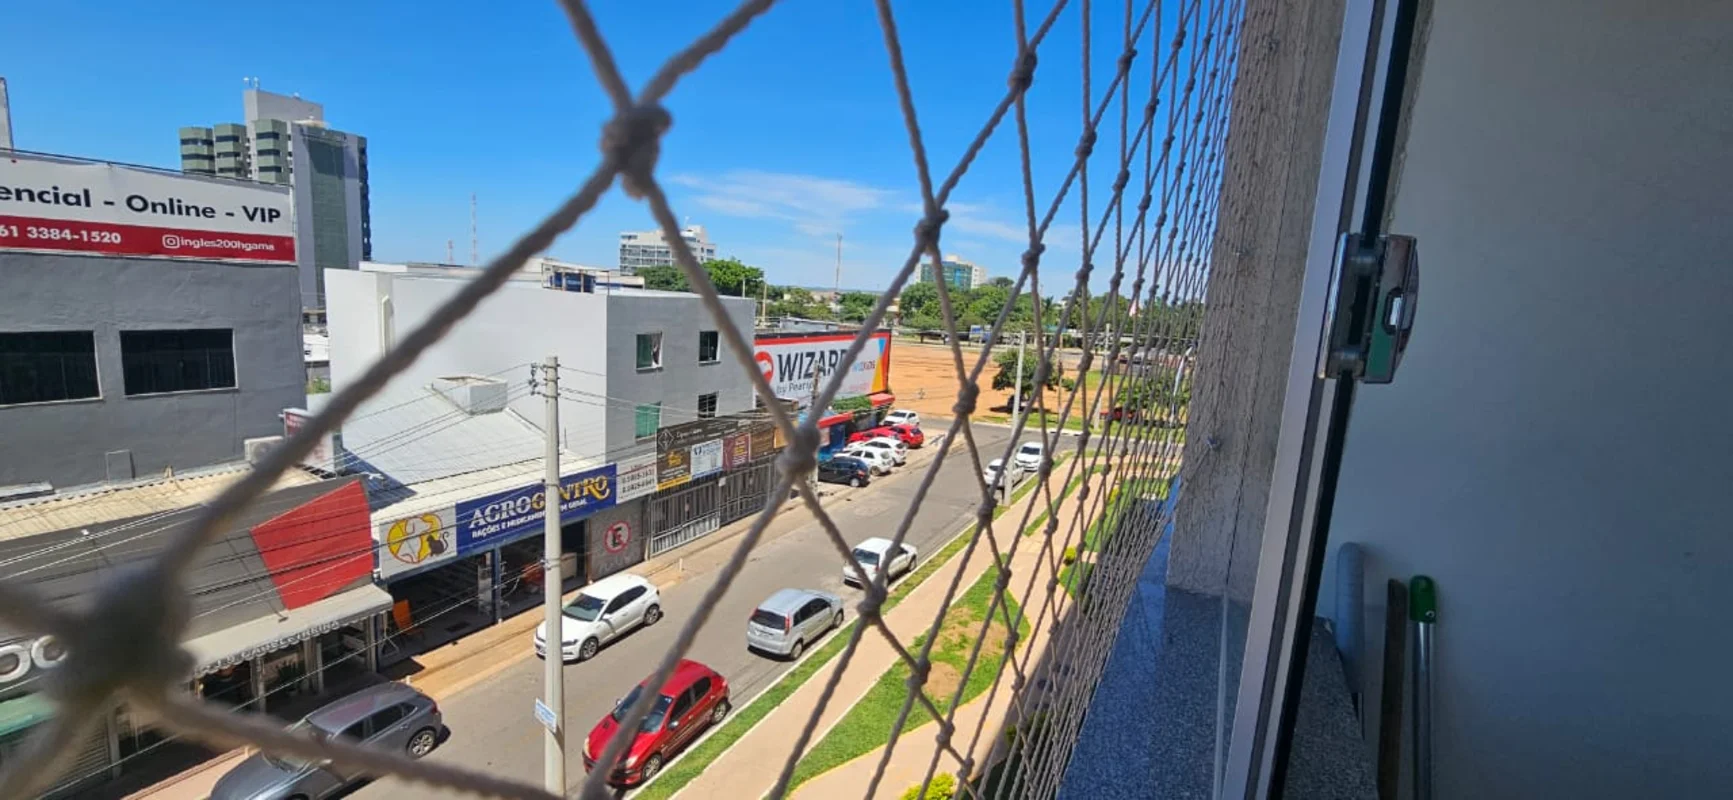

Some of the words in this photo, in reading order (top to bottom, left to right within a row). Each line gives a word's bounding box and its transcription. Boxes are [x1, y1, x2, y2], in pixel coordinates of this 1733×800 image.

[126, 194, 217, 219] Online
[242, 205, 281, 223] VIP
[26, 226, 121, 244] 3384-1520
[468, 475, 611, 529] AGROCNTRO
